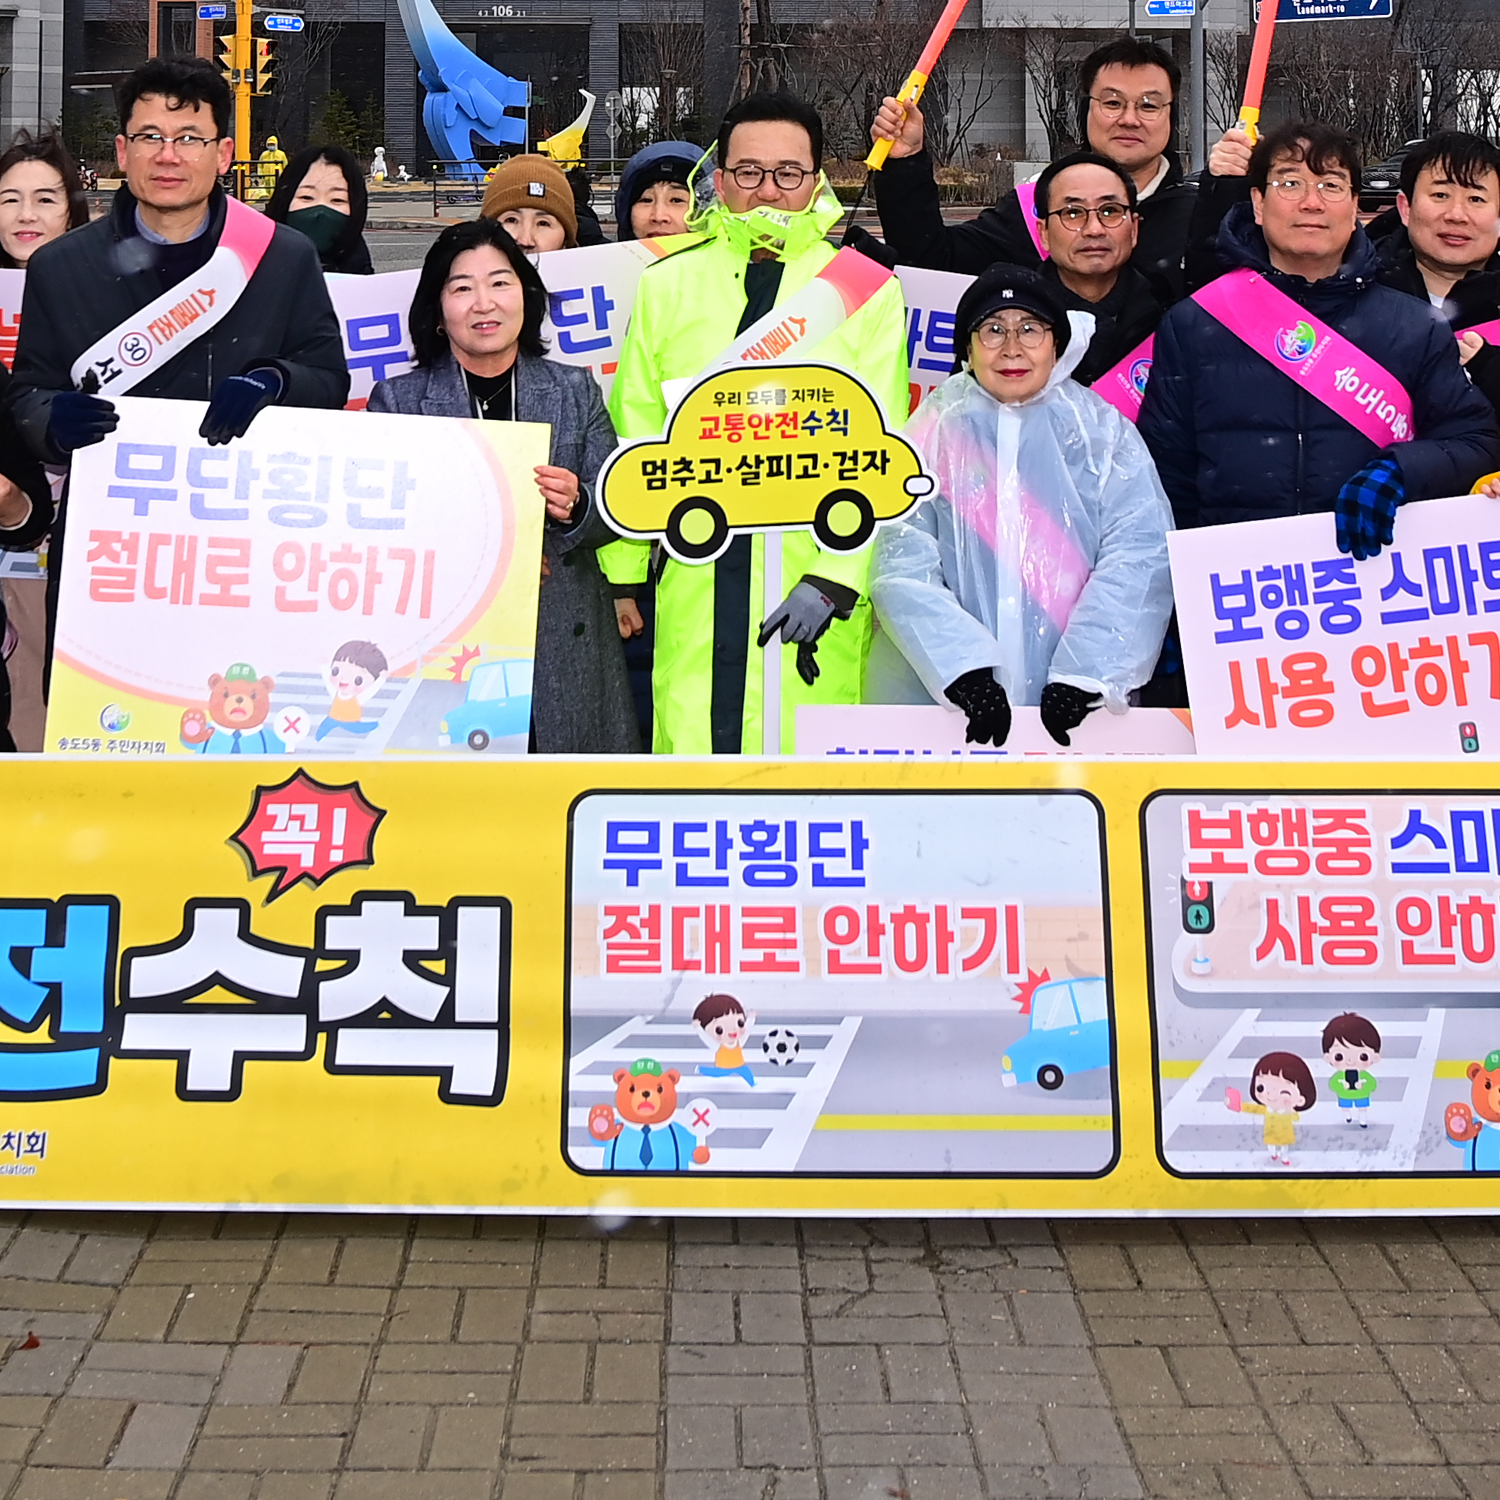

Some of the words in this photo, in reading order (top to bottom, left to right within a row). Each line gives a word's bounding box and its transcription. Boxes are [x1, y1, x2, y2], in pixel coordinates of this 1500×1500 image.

[492, 5, 513, 17] 106
[1297, 4, 1345, 15] Landmark-ro
[124, 337, 147, 362] 30
[147, 288, 217, 346] 스쿨존
[698, 408, 849, 443] 교통안전수칙
[713, 391, 741, 407] 우리
[746, 389, 787, 405] 모두를
[791, 387, 835, 403] 지키는
[1334, 366, 1408, 439] 송도5동
[107, 442, 416, 531] 무단횡단
[87, 531, 251, 608] 절대로
[271, 541, 435, 619] 안하기
[1209, 555, 1362, 646] 보행중
[1224, 650, 1336, 730] 사용
[57, 737, 102, 753] 송도5동
[106, 738, 167, 754] 주민자치회
[257, 799, 348, 871] 꼭!
[602, 819, 868, 891] 무단횡단
[1187, 806, 1370, 879] 보행중
[602, 902, 800, 978] 절대로
[822, 905, 1022, 978] 안하기
[1254, 895, 1376, 970] 사용
